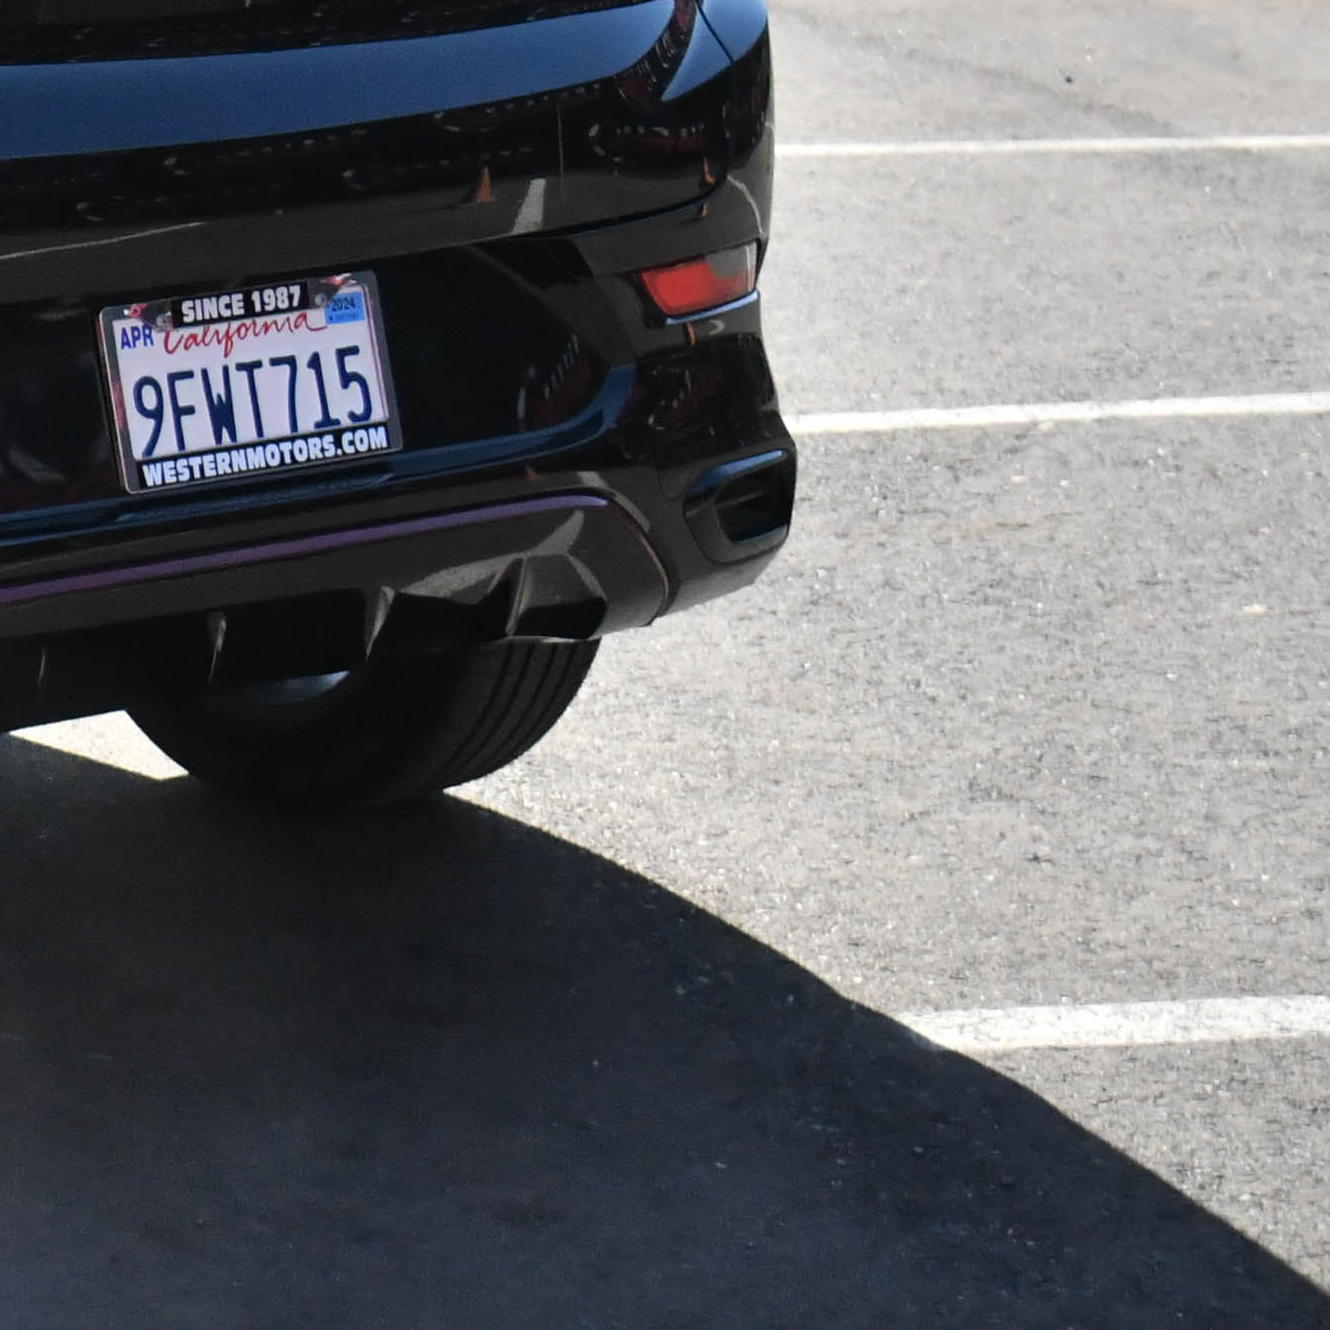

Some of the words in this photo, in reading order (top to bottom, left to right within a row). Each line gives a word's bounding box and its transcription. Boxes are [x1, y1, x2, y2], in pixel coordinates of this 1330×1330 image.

[181, 292, 246, 323] SINCE
[251, 285, 302, 311] 1987
[331, 297, 357, 312] 2024
[120, 323, 155, 350] APR
[163, 312, 328, 359] California
[132, 345, 374, 458] 9FWT715
[142, 425, 389, 488] WESTERNMOTORS.COM
